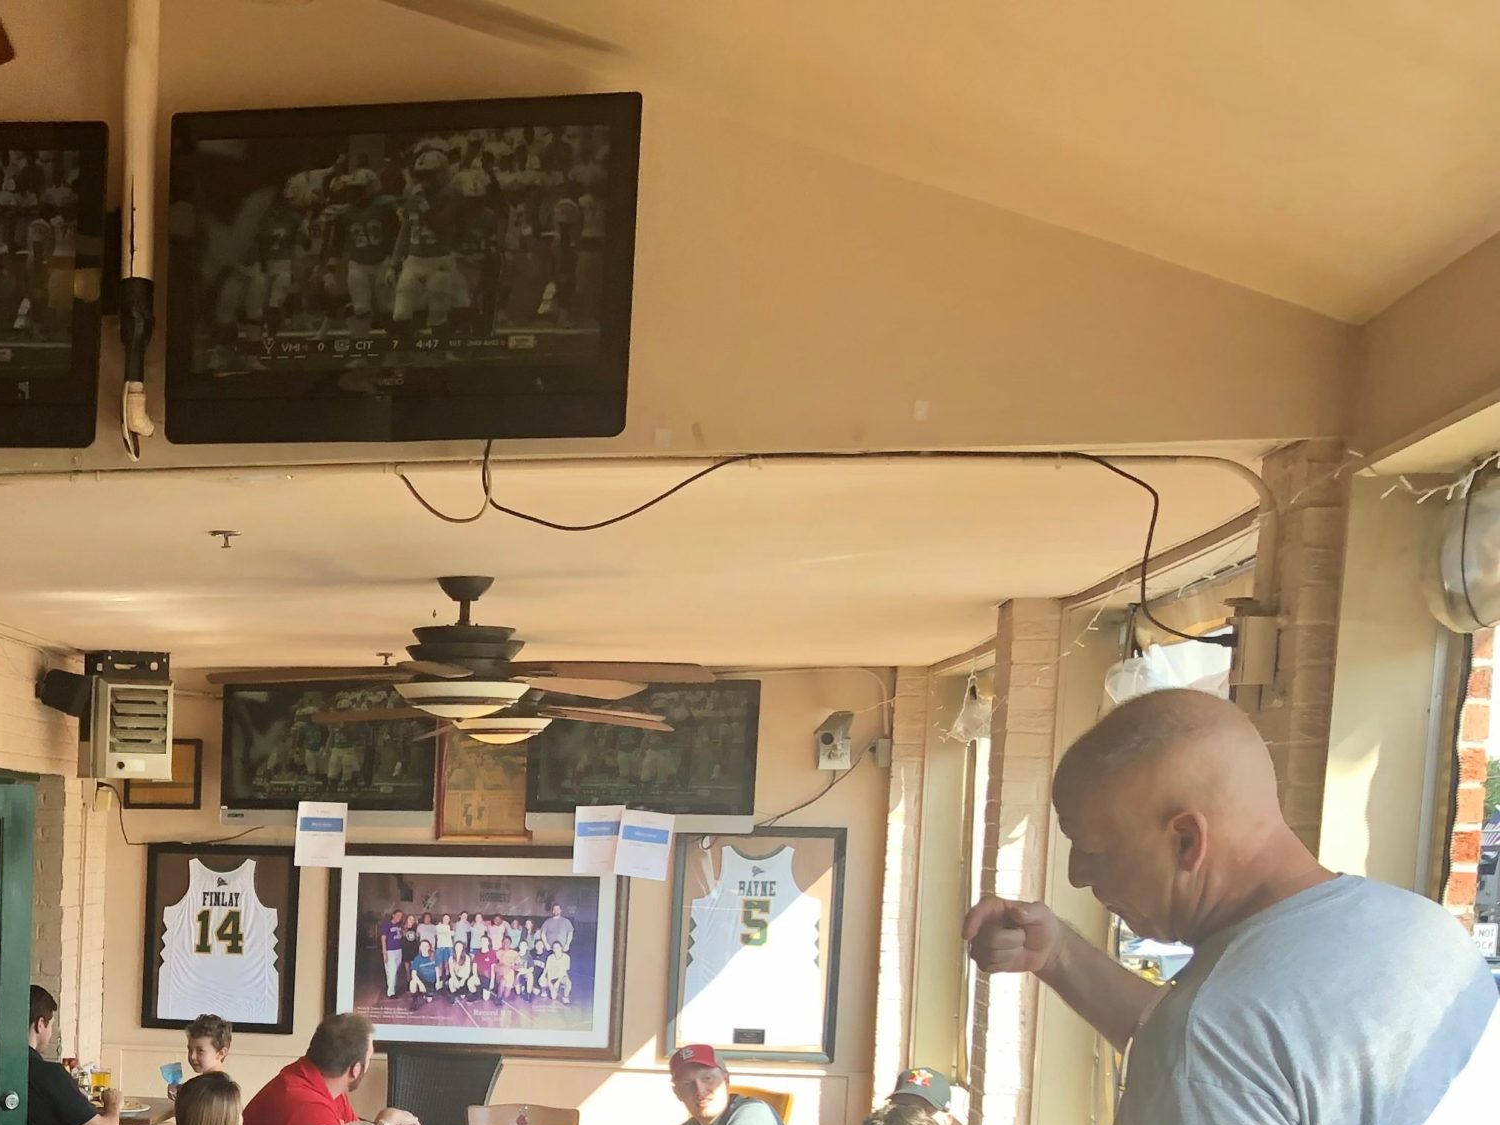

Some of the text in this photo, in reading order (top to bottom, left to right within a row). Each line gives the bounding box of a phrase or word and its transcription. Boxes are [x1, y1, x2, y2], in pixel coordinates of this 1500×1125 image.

[280, 343, 301, 353] VMI
[355, 340, 374, 350] CIT
[391, 341, 399, 350] 7
[415, 339, 439, 350] 4:47
[738, 880, 777, 897] BAYNE
[202, 891, 240, 907] FINLAY
[739, 899, 771, 947] 5
[193, 908, 245, 955] 14
[1478, 929, 1495, 938] NOT
